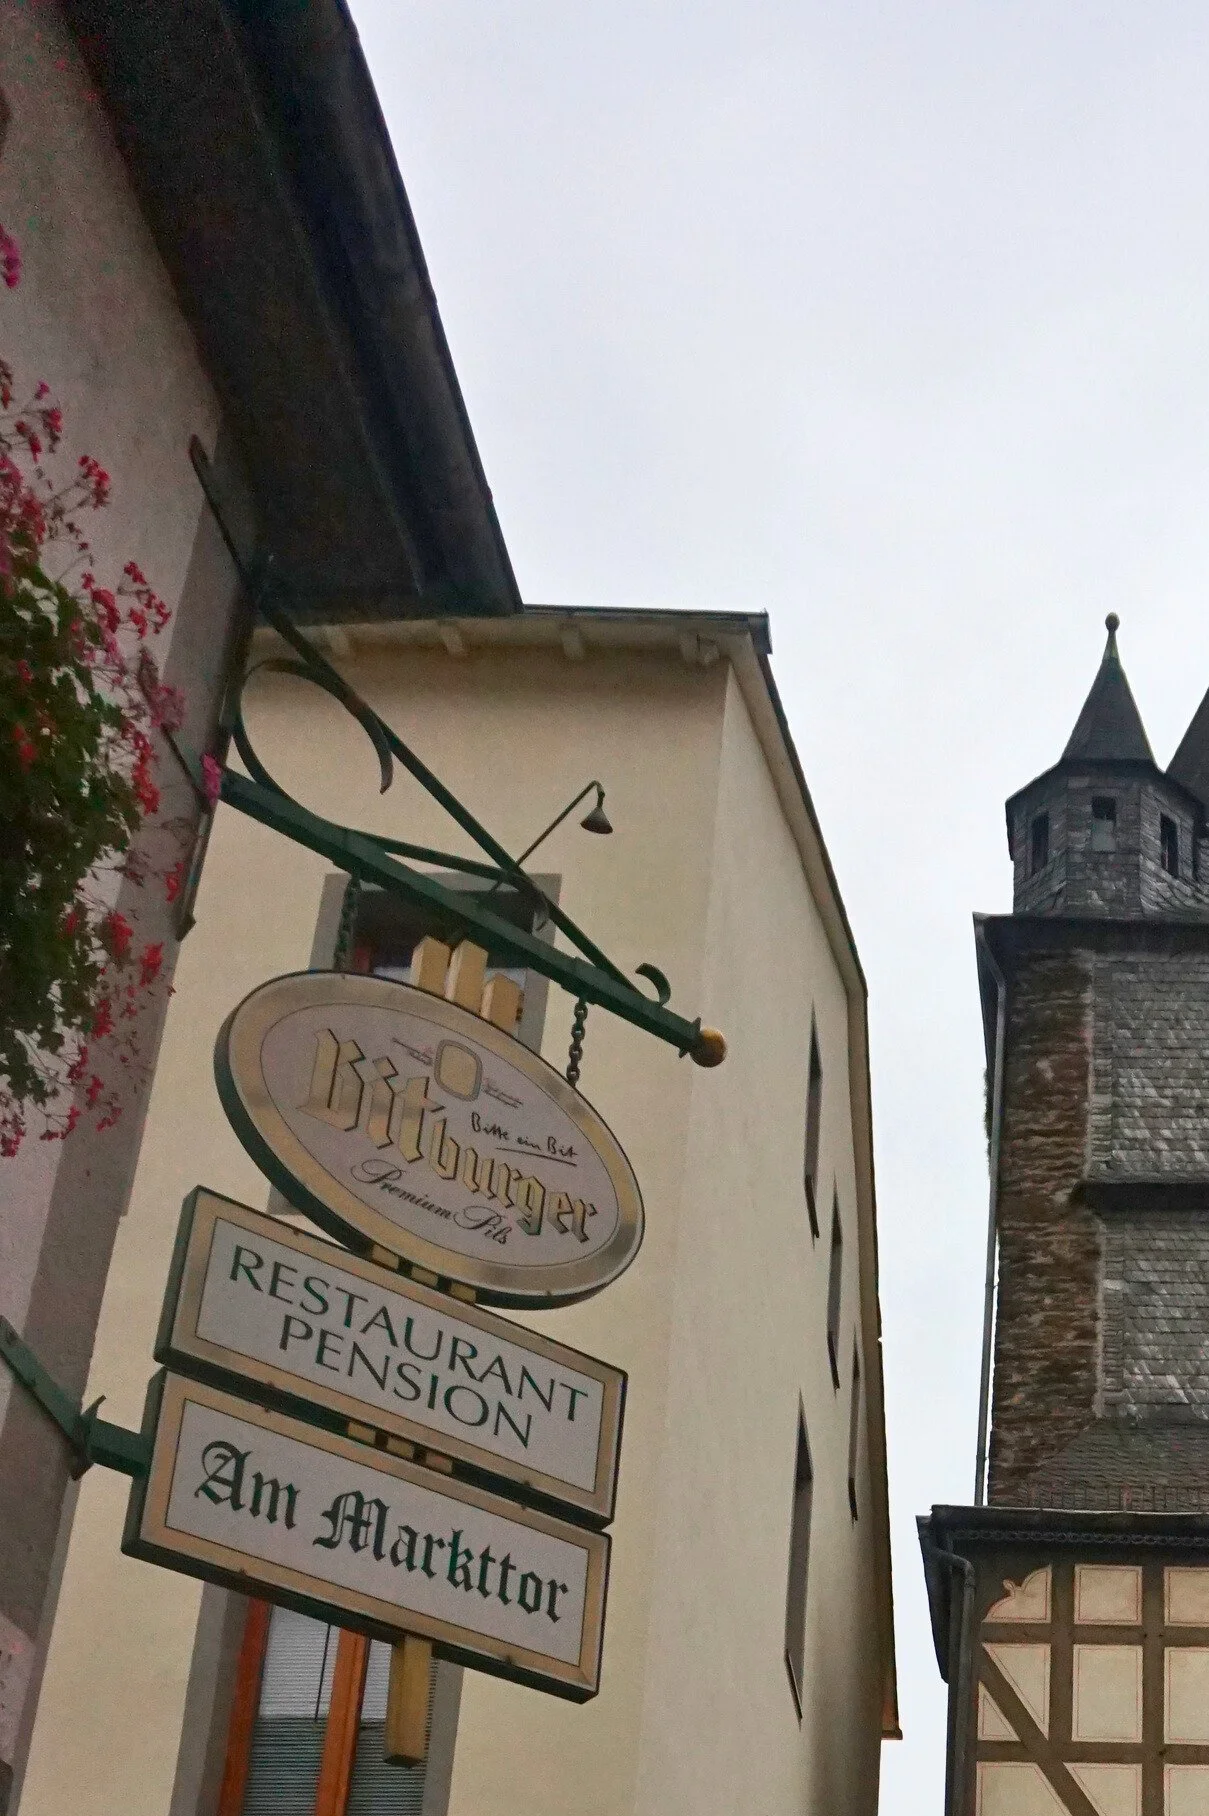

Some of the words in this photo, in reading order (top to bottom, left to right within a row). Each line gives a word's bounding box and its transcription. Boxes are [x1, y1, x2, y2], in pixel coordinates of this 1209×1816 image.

[297, 1028, 597, 1243] Bitburger
[351, 1159, 452, 1219] Premium
[453, 1205, 512, 1245] Pils
[471, 1111, 509, 1140] Bitte
[515, 1136, 541, 1151] ein
[547, 1136, 578, 1157] Bit
[229, 1245, 589, 1421] RESTAURANT
[278, 1315, 532, 1449] PENSION
[194, 1441, 301, 1530] Am
[312, 1490, 568, 1623] Markttor
